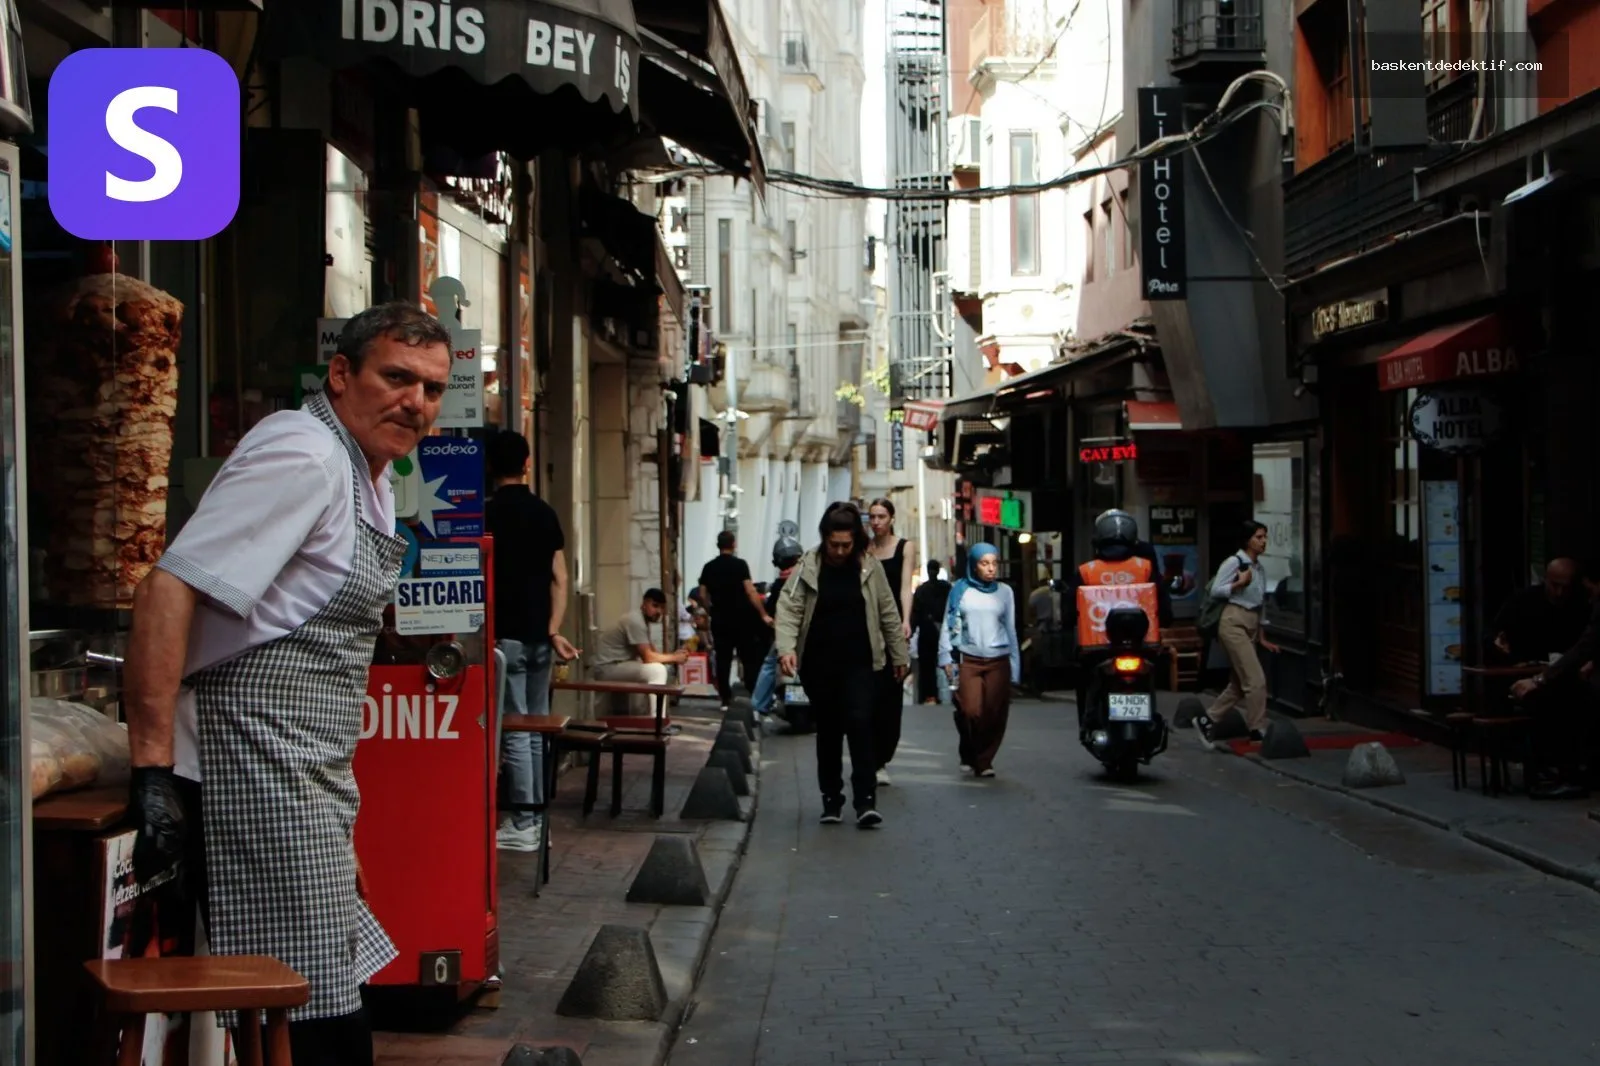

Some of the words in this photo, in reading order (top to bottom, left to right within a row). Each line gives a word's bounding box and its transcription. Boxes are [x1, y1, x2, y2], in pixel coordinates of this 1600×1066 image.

[526, 19, 595, 75] BEY
[1149, 279, 1179, 293] Pera
[1456, 348, 1520, 376] ALBA
[452, 374, 475, 383] Ticket
[447, 382, 475, 390] aurant
[1438, 397, 1482, 416] ALBA
[422, 442, 478, 456] sodexo
[398, 580, 486, 607] SETCARD
[1111, 695, 1123, 705] 34
[1122, 706, 1141, 716] 747
